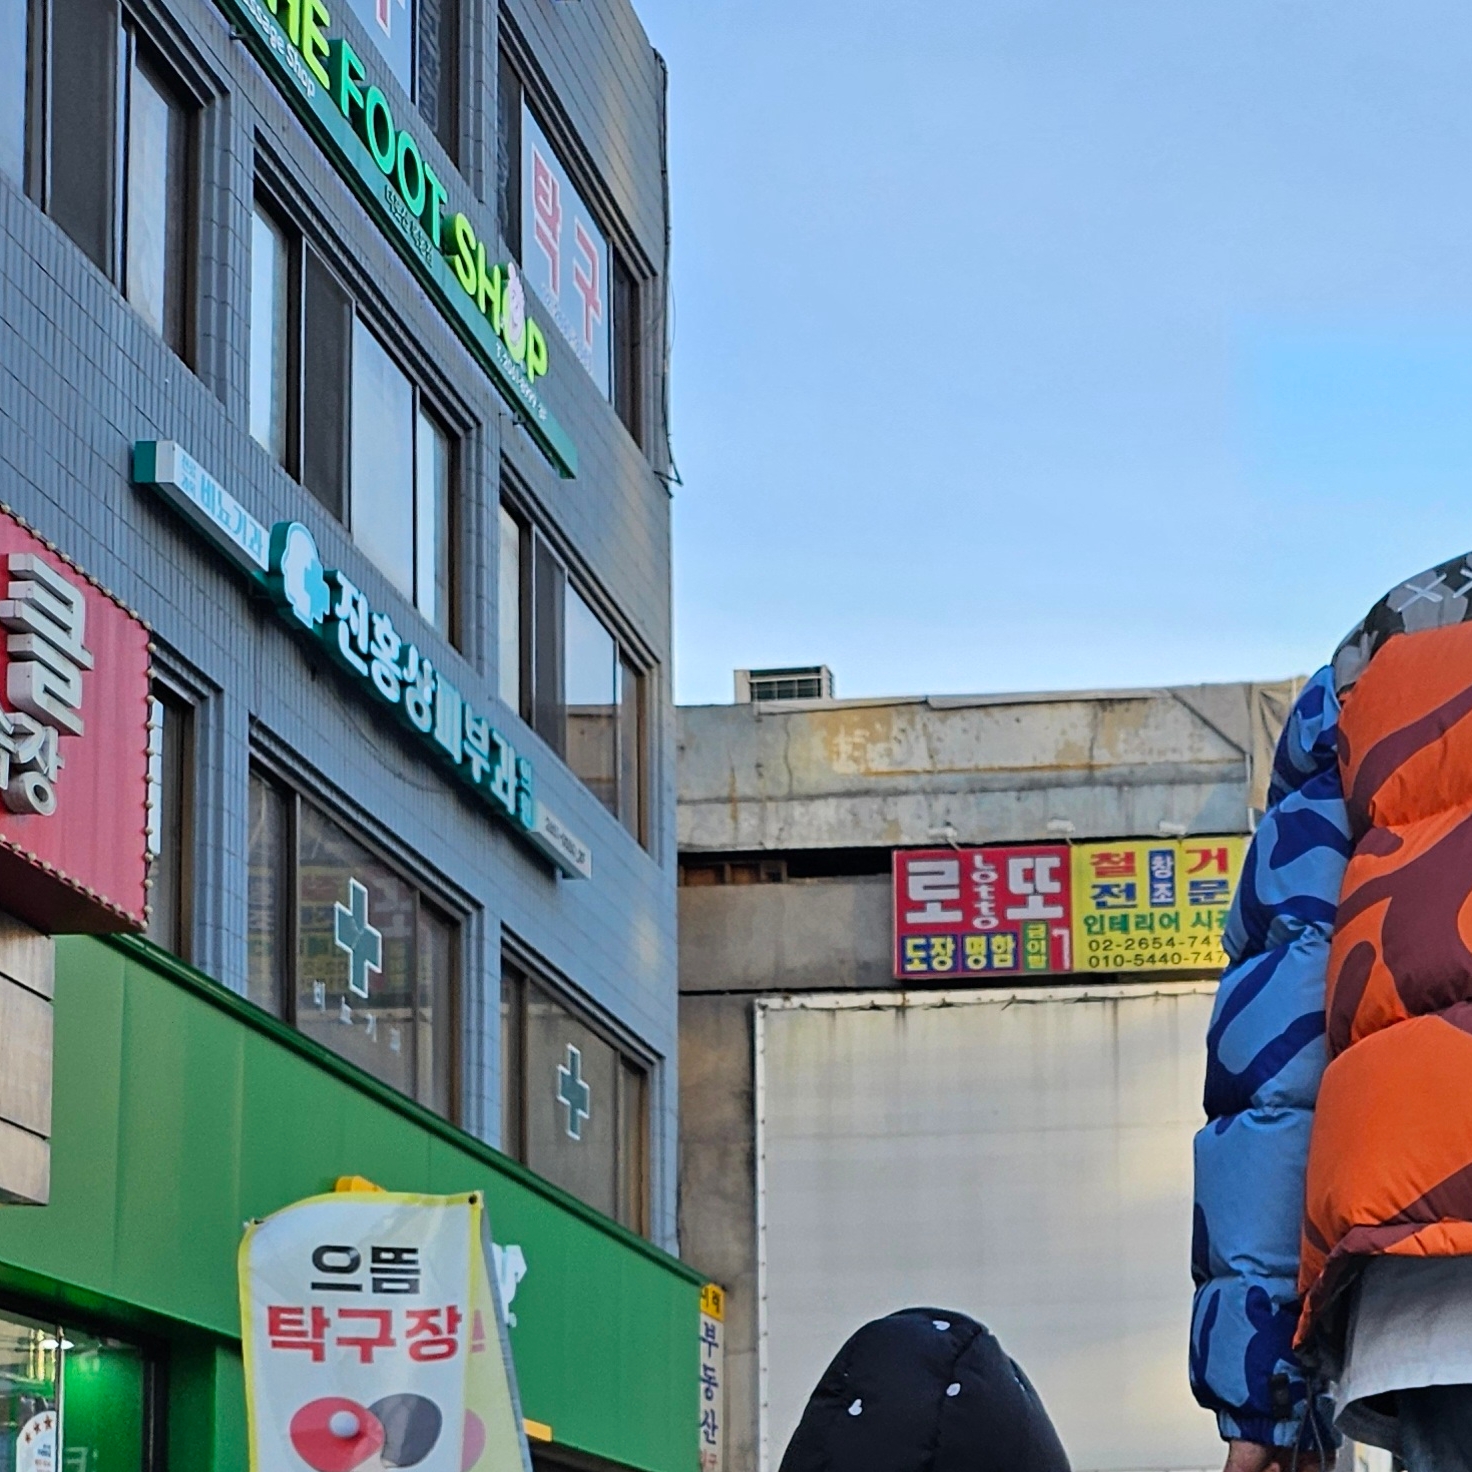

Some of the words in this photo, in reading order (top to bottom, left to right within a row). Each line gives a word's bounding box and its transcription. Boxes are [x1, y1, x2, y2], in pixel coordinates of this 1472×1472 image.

[286, 43, 315, 98] Shop
[342, 39, 448, 248] FOOT
[455, 212, 548, 384] SHOP
[532, 142, 602, 346] 탁구
[1083, 911, 1180, 935] 인테리어
[905, 934, 955, 971] 도장
[965, 933, 1015, 970] 명함
[311, 1245, 420, 1294] 으뜸
[267, 1305, 463, 1363] 탁구장
[699, 1321, 719, 1445] 부동산
